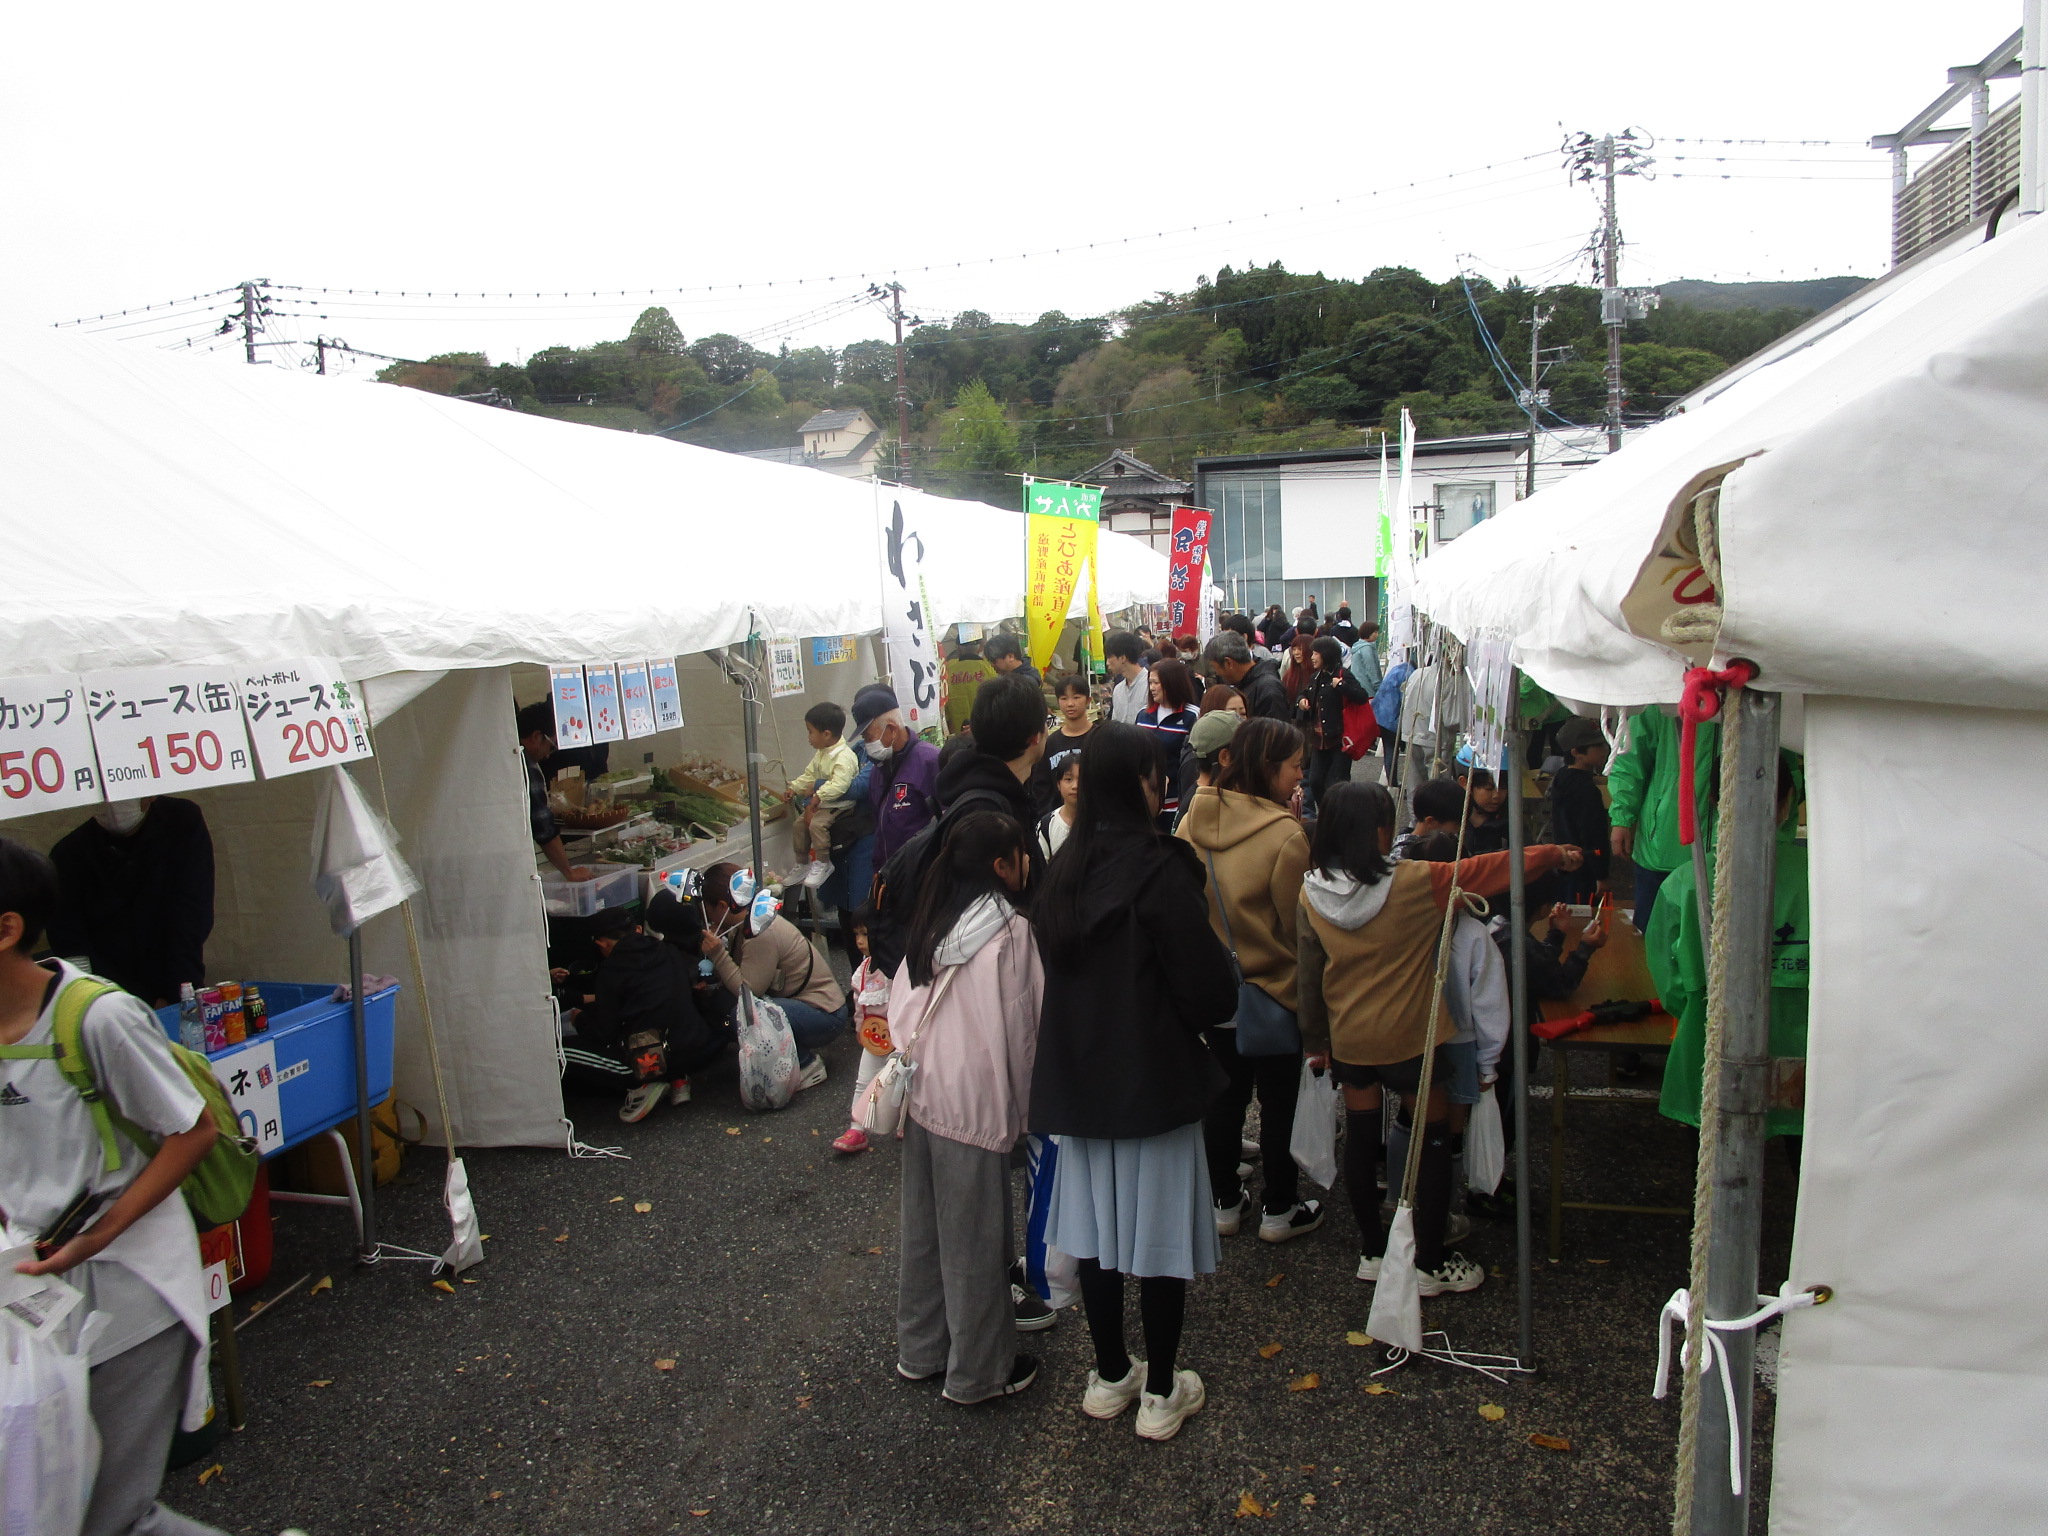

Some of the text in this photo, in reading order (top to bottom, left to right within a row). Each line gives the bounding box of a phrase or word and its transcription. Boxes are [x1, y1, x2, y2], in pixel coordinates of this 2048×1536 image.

[884, 500, 937, 709] わさび
[775, 649, 794, 664] 遠野産
[246, 670, 300, 687] ペットボトル
[776, 666, 795, 681] やさい
[951, 670, 985, 684] がんせ
[561, 687, 577, 700] ミニ
[592, 683, 613, 697] トマト
[625, 685, 647, 699] すくい
[107, 763, 147, 784] 500ml
